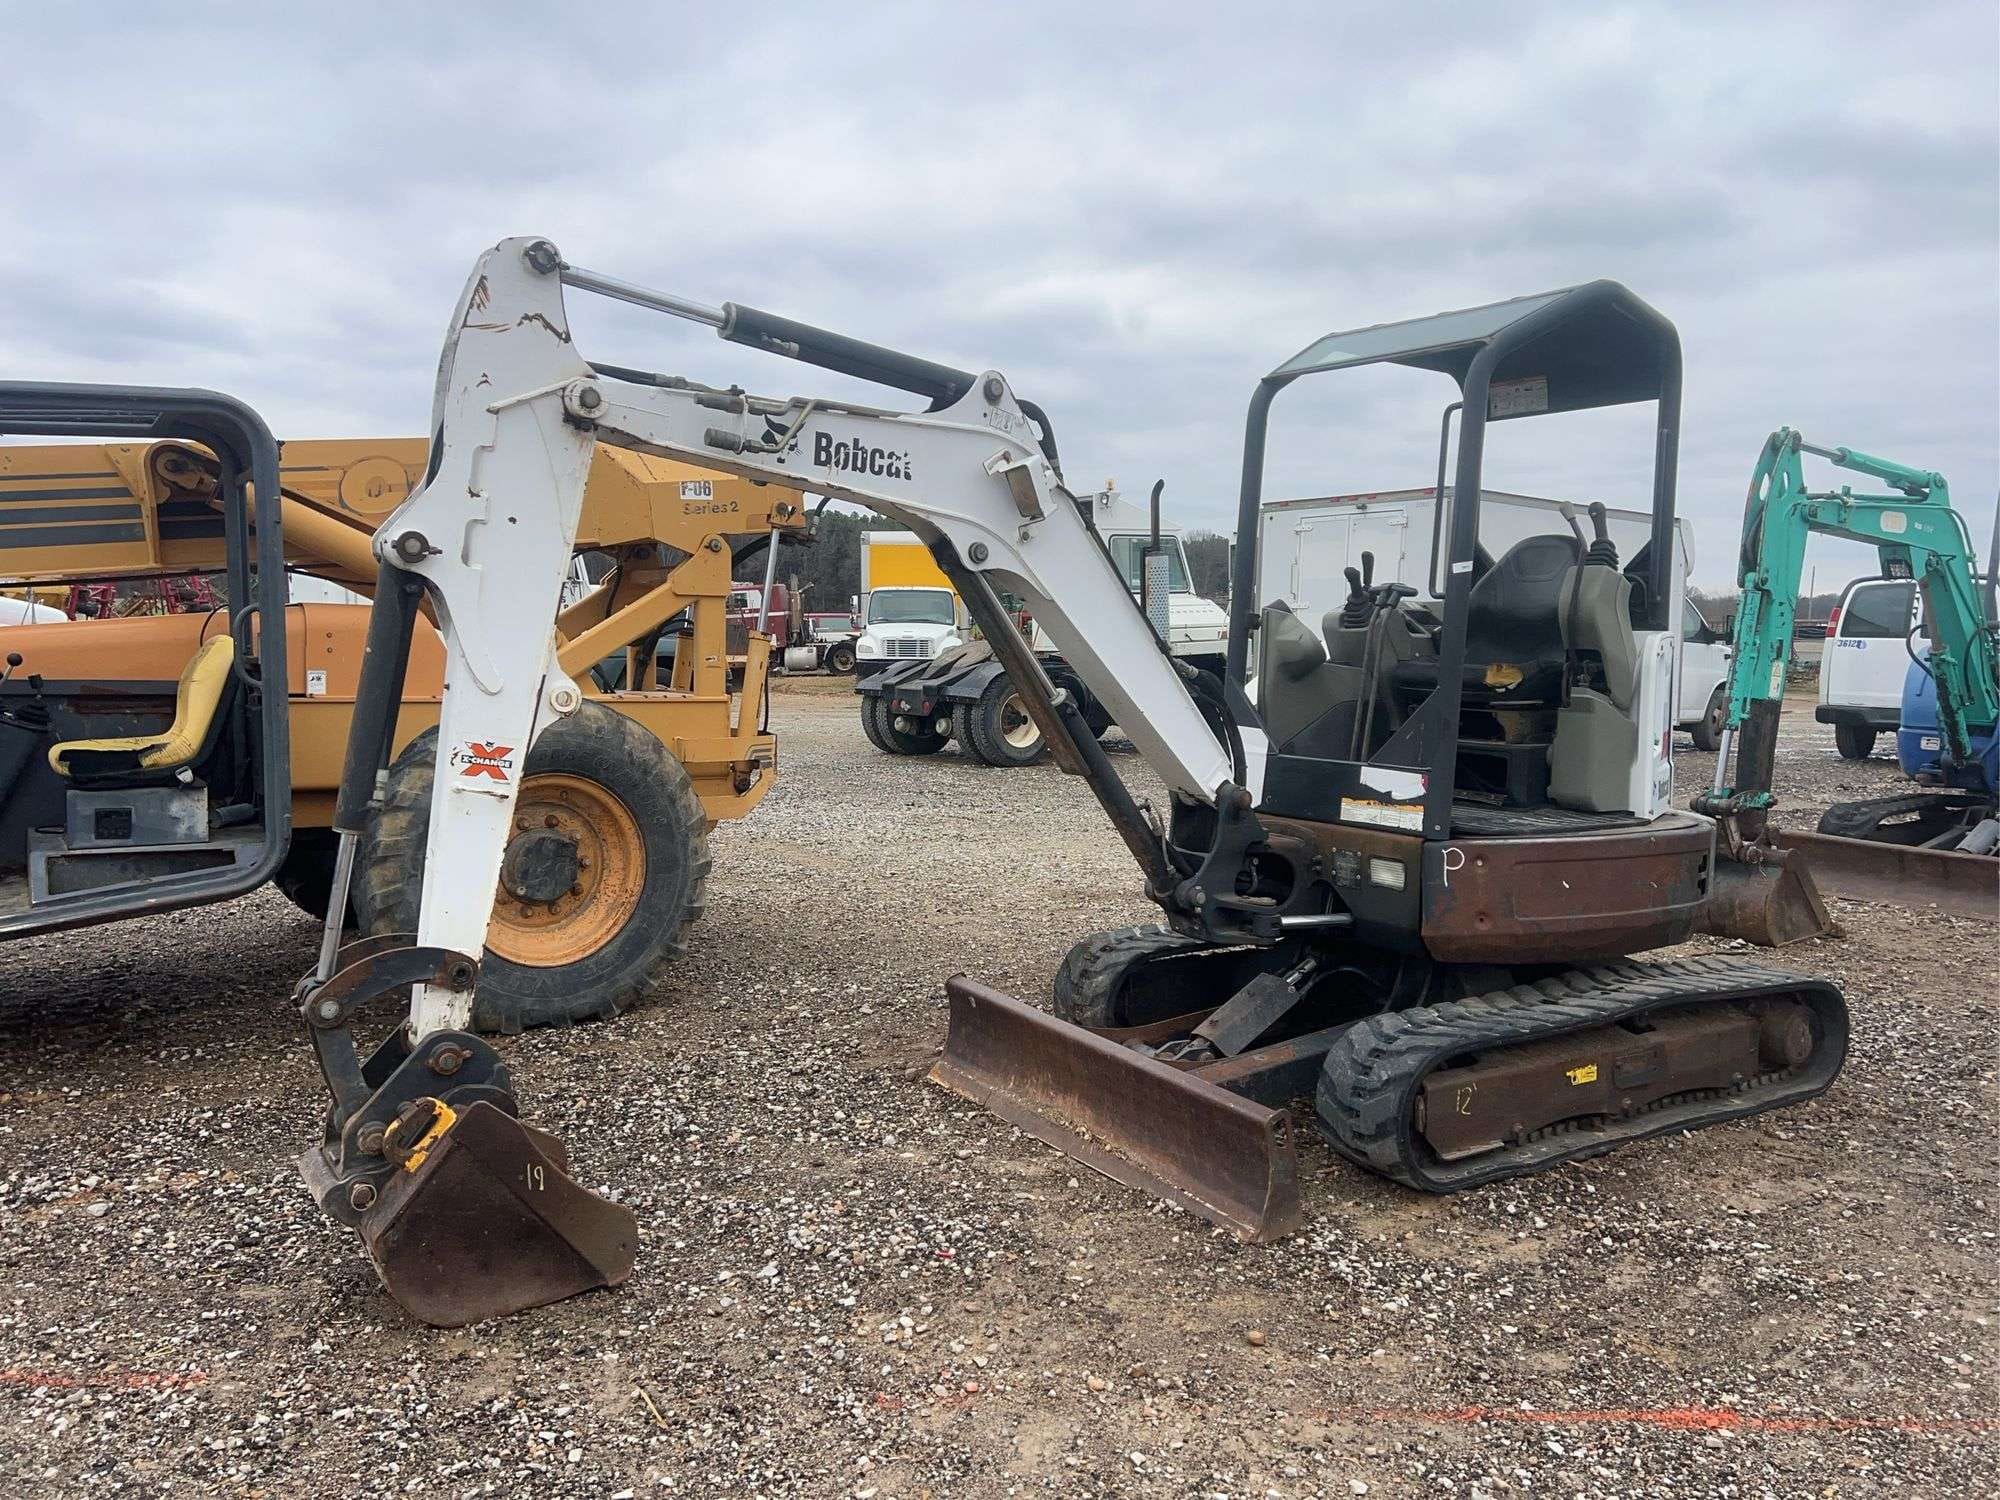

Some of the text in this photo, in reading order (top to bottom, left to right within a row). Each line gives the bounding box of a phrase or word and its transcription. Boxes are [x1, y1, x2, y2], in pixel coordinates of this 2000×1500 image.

[462, 755, 512, 768] X-CHANGE
[1442, 847, 1465, 887] P
[527, 1163, 544, 1190] 19
